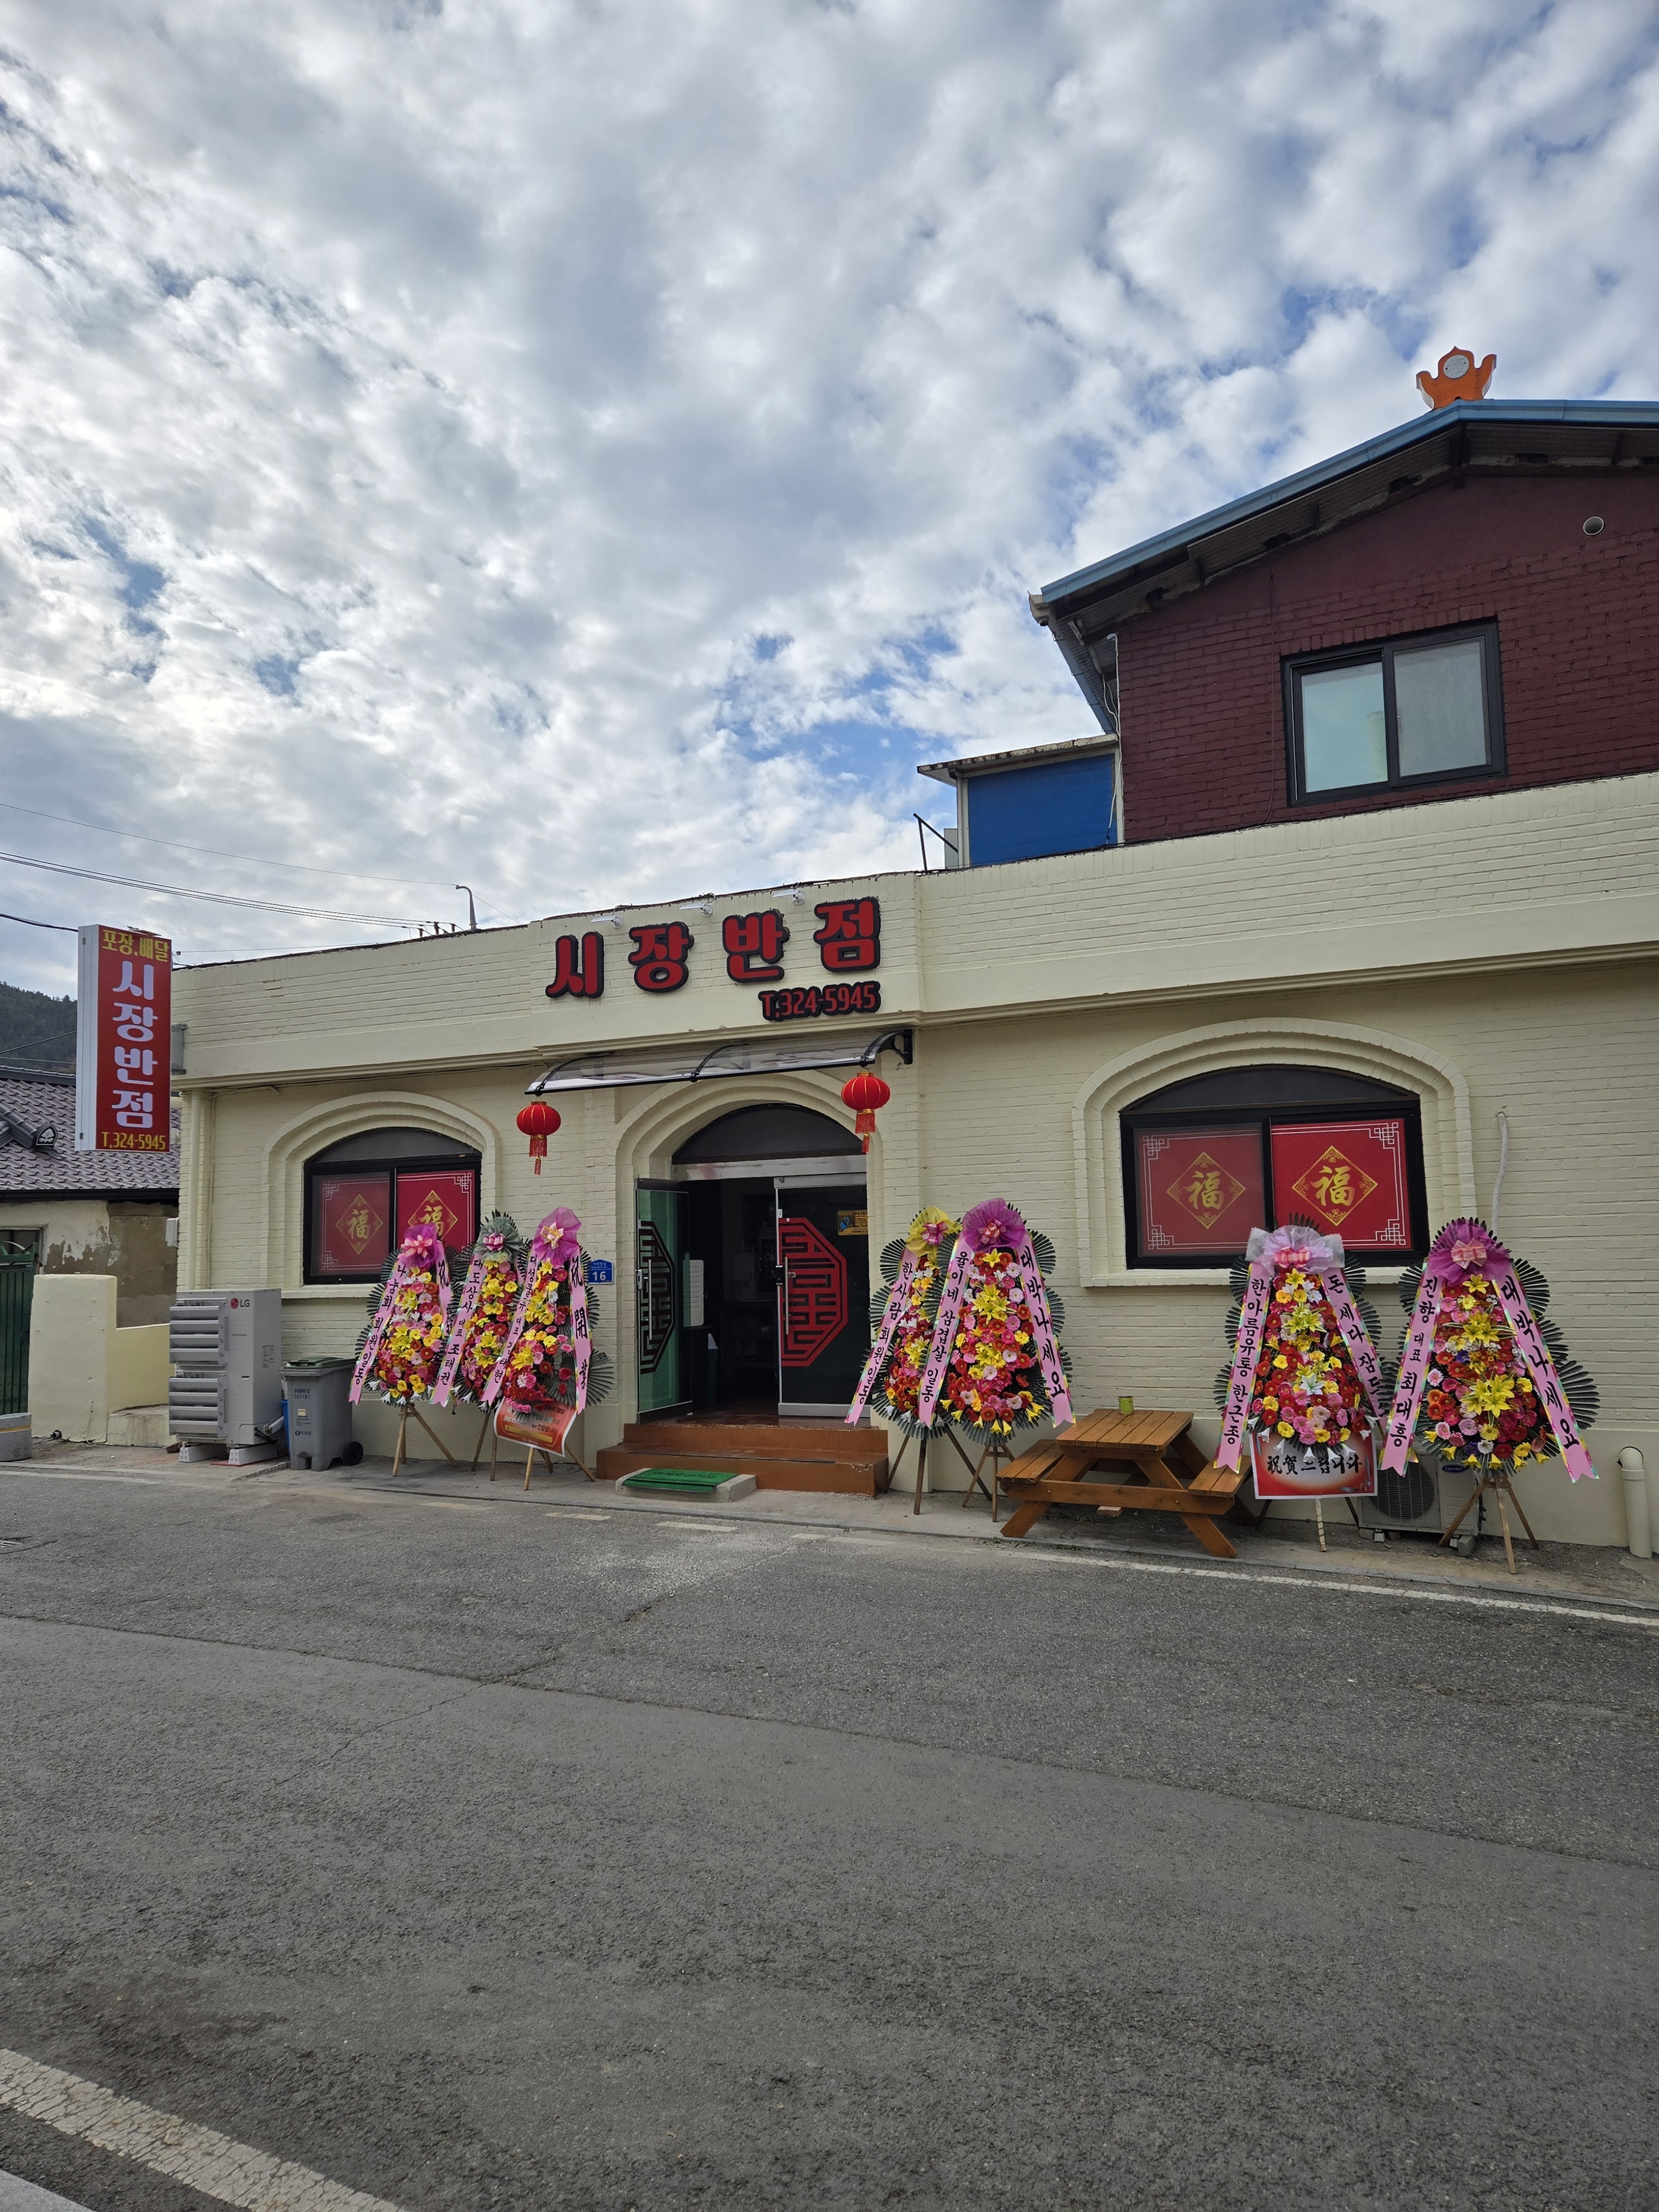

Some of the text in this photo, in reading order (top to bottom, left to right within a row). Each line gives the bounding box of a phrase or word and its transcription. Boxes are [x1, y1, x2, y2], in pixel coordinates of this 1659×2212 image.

[102, 929, 170, 962] 포장.배달
[545, 896, 881, 998] 시장반점
[760, 983, 879, 1020] T.324-5945
[112, 961, 158, 1129] 시장반점
[101, 1132, 166, 1150] T.324-5945
[1183, 1170, 1224, 1210] 福
[1310, 1166, 1355, 1206] 福
[346, 1209, 370, 1239] 福
[592, 1271, 606, 1281] 16
[1328, 1275, 1344, 1293] 돈
[1340, 1303, 1365, 1343] 세다
[354, 1265, 406, 1385] 나눔회 회원일동
[440, 1259, 483, 1385] 대도상사 대표 조태권
[513, 1317, 521, 1335] 대표
[859, 1262, 913, 1404] 한사람 회원일동
[921, 1251, 969, 1402] 율이네 삼겹살 일동
[1020, 1245, 1065, 1397] 대박나세요
[1223, 1279, 1266, 1444] 한아름유통 한근종
[1390, 1276, 1438, 1447] 진향 대표 최대흥
[1500, 1275, 1579, 1449] 대박나세요
[538, 1424, 557, 1434] 인증합니다
[1267, 1454, 1298, 1475] 祝賀
